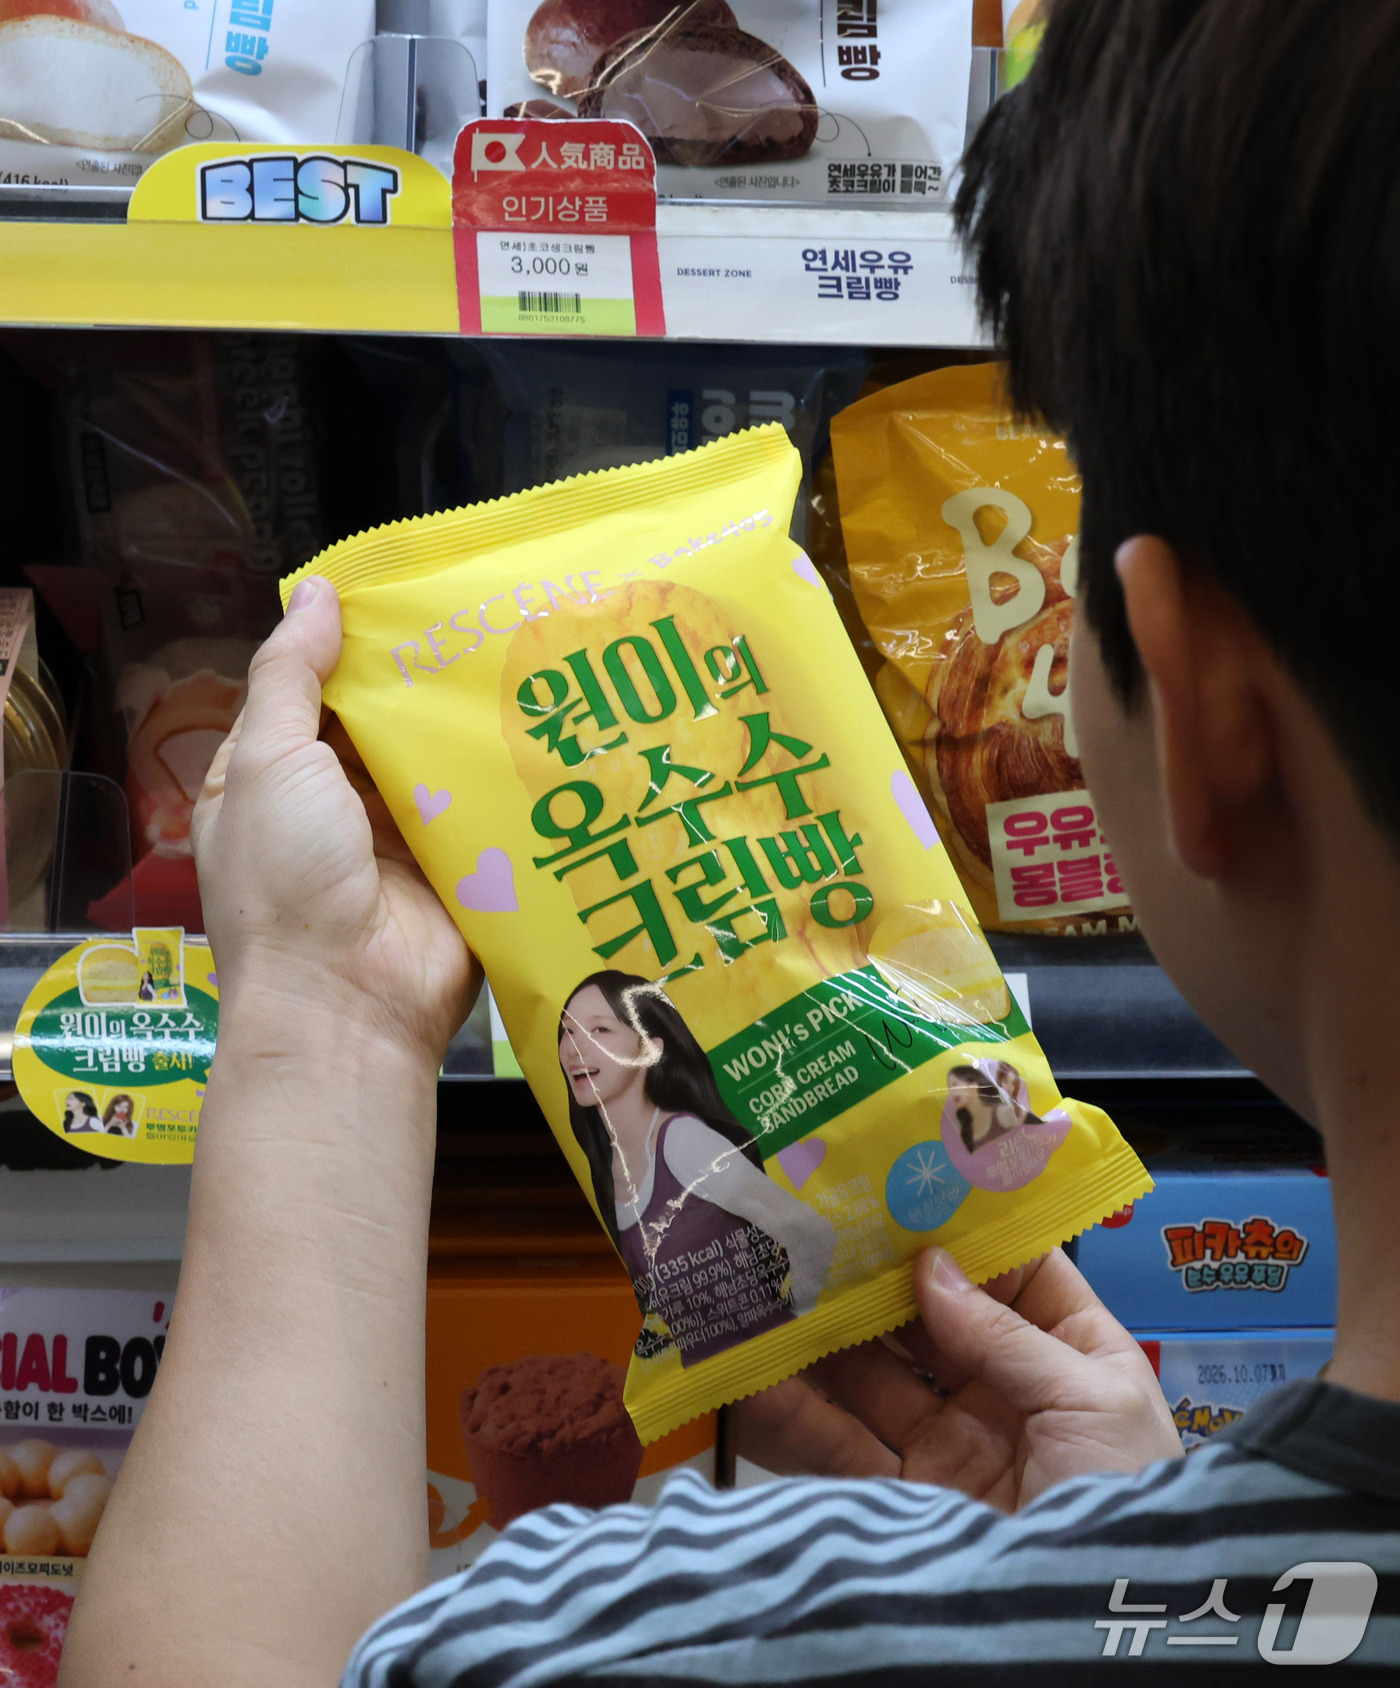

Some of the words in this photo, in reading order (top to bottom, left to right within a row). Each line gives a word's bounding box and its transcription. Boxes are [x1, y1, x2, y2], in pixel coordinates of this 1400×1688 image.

[530, 141, 646, 171] 人気商品
[828, 163, 897, 180] 연세우유가
[198, 155, 398, 224] BEST
[828, 179, 897, 195] 초코크림이
[502, 196, 609, 222] 인기상품
[676, 267, 720, 278] DESSERT
[723, 268, 753, 279] ZONE
[801, 248, 914, 275] 연세우유
[817, 275, 902, 301] 크림빵
[516, 615, 769, 768] 원이의
[531, 712, 831, 882] 옥수수
[1003, 805, 1105, 857] 우유
[577, 810, 874, 986] 크림빵
[806, 989, 864, 1032] PICK
[59, 1012, 127, 1039] 원이의
[130, 1012, 204, 1040] 옥수수
[73, 1046, 147, 1073] 크림빵
[152, 1051, 193, 1072] 출시!
[749, 1075, 798, 1114] CORN
[796, 1039, 857, 1084] CREAM
[759, 1065, 860, 1134] SANDBREAD
[1164, 1217, 1304, 1267] 피카츄의
[655, 1255, 689, 1284] (335
[690, 1239, 724, 1266] kcal)
[707, 1299, 750, 1321] 스위트콘
[0, 1400, 39, 1421] 함이
[47, 1402, 65, 1422] 한
[72, 1403, 133, 1424] 박스에!
